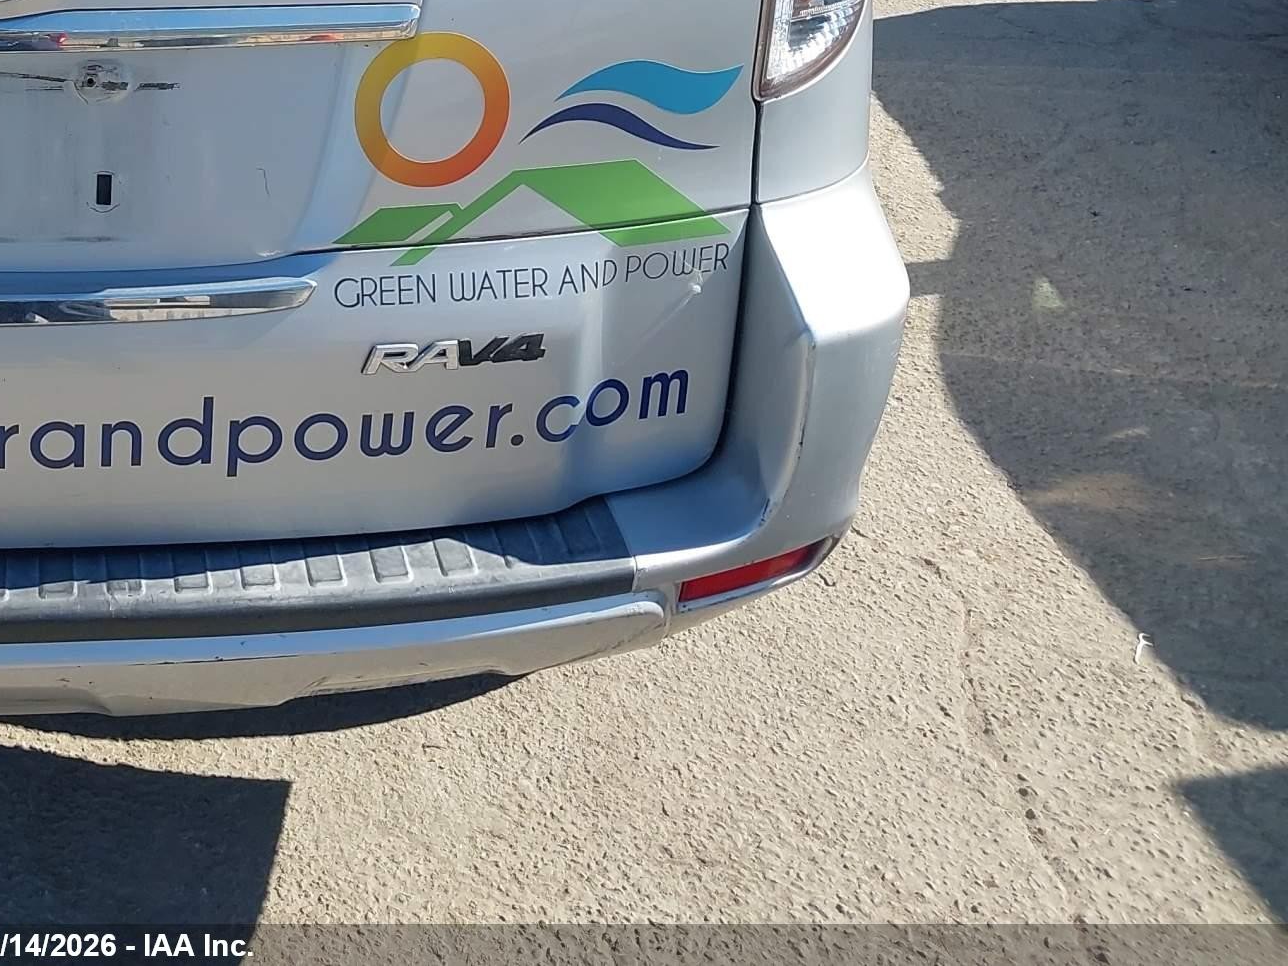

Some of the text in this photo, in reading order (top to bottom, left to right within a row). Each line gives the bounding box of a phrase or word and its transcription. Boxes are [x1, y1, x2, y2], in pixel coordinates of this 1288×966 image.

[333, 242, 731, 309] GREEN WATER AND POWER
[360, 332, 547, 376] RAV4
